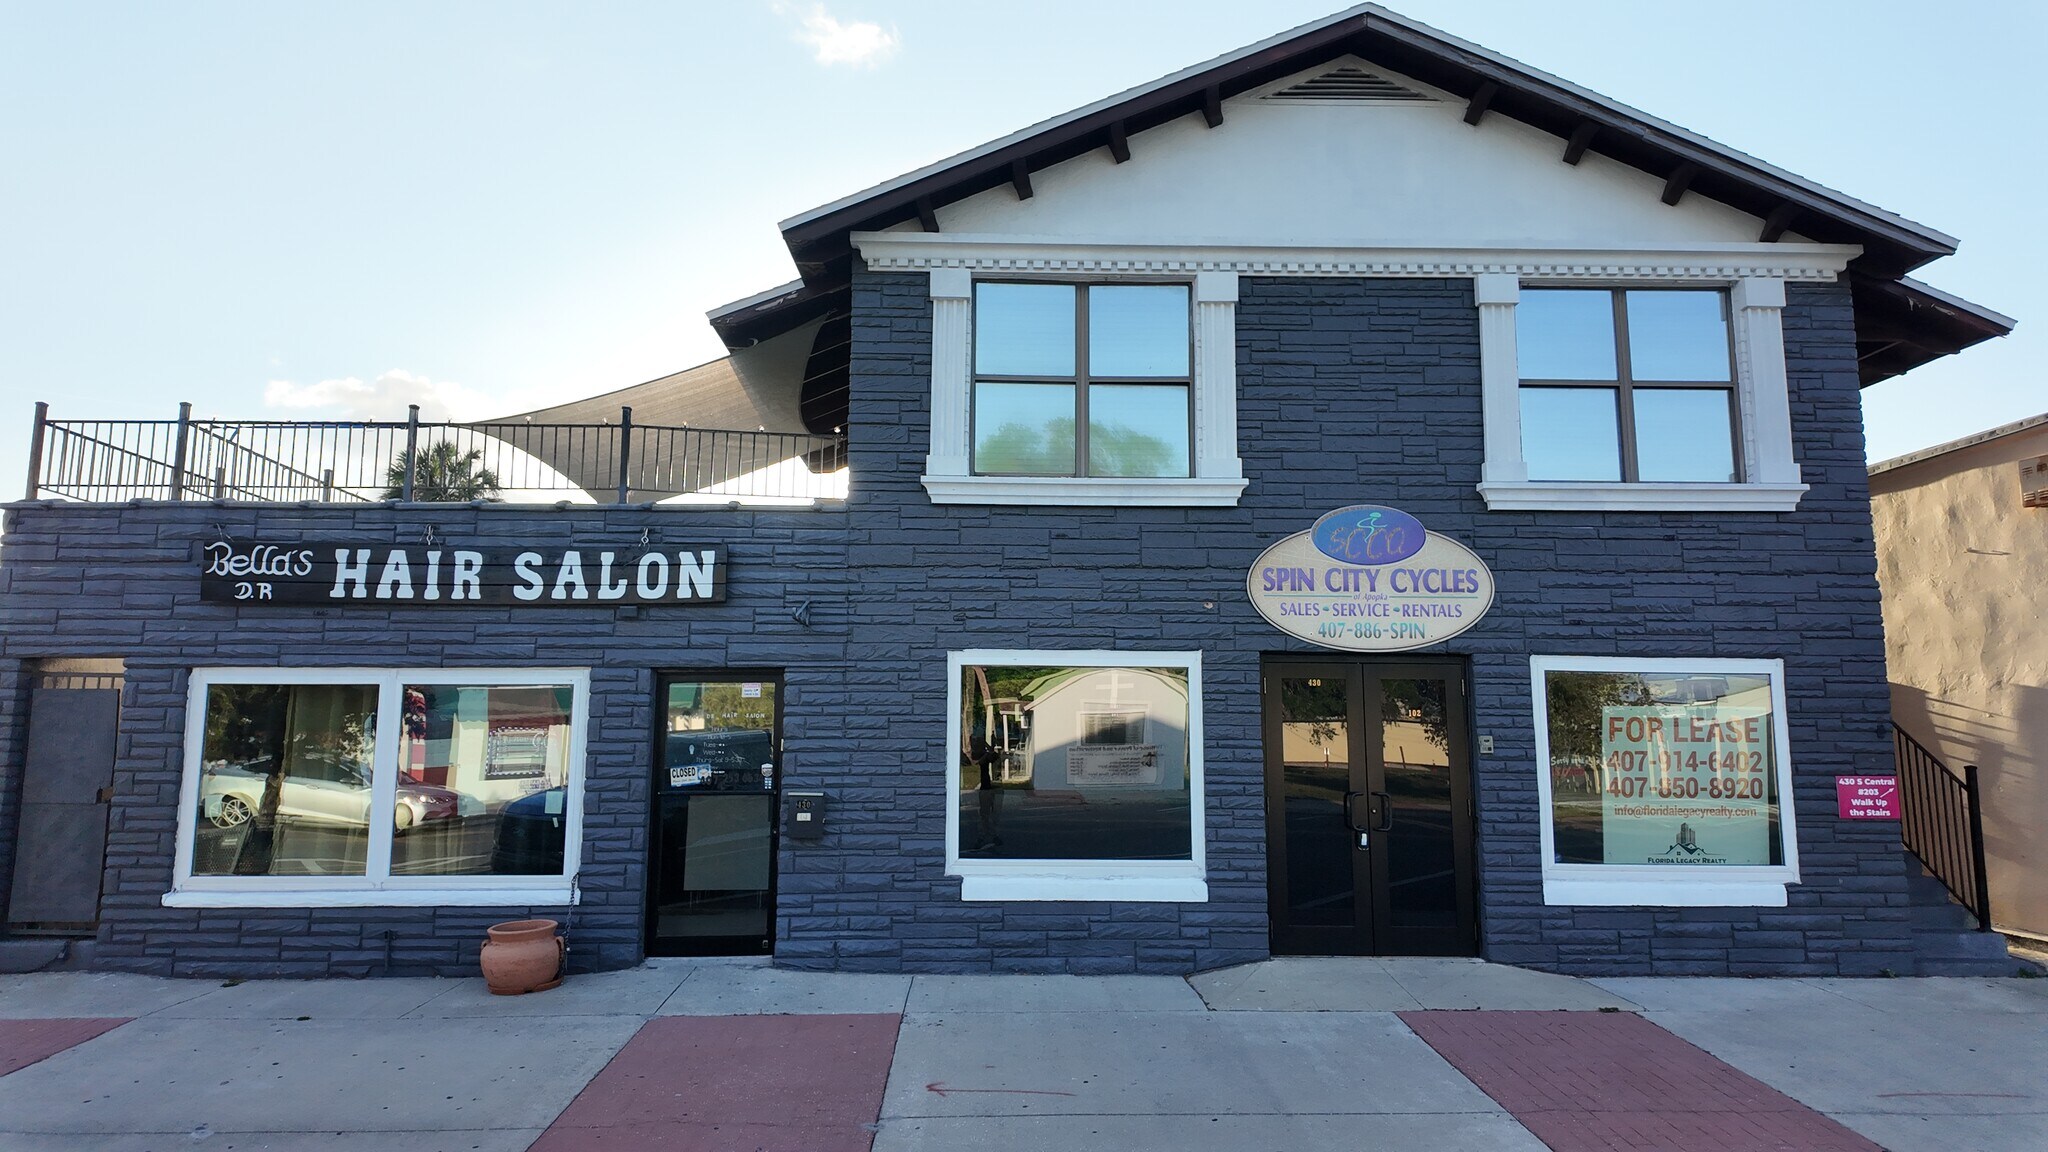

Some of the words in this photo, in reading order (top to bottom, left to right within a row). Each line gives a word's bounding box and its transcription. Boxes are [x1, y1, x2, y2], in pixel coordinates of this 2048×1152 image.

[204, 541, 314, 577] Bella's
[329, 548, 484, 601] HAIR
[513, 549, 717, 601] SALON
[1262, 567, 1315, 592] SPIN
[1324, 568, 1380, 593] CITY
[1389, 569, 1479, 594] CYCLES
[1353, 592, 1361, 600] of
[1362, 593, 1388, 602] Apopka
[1280, 602, 1320, 617] SALES
[1332, 603, 1390, 617] SERVICE
[1402, 603, 1462, 618] RENTALS
[1318, 622, 1425, 640] 407-886-SPIN
[1308, 678, 1321, 687] 430
[1408, 709, 1422, 717] 102
[1608, 716, 1663, 743] FOR
[1673, 717, 1760, 743] LEASE
[1606, 750, 1763, 773] 407-914-6402
[672, 767, 696, 778] CLOSED
[1607, 777, 1763, 799] 407-850-8920
[1614, 805, 1757, 818] info@floridalegacyrealty.com
[1875, 799, 1888, 807] Up
